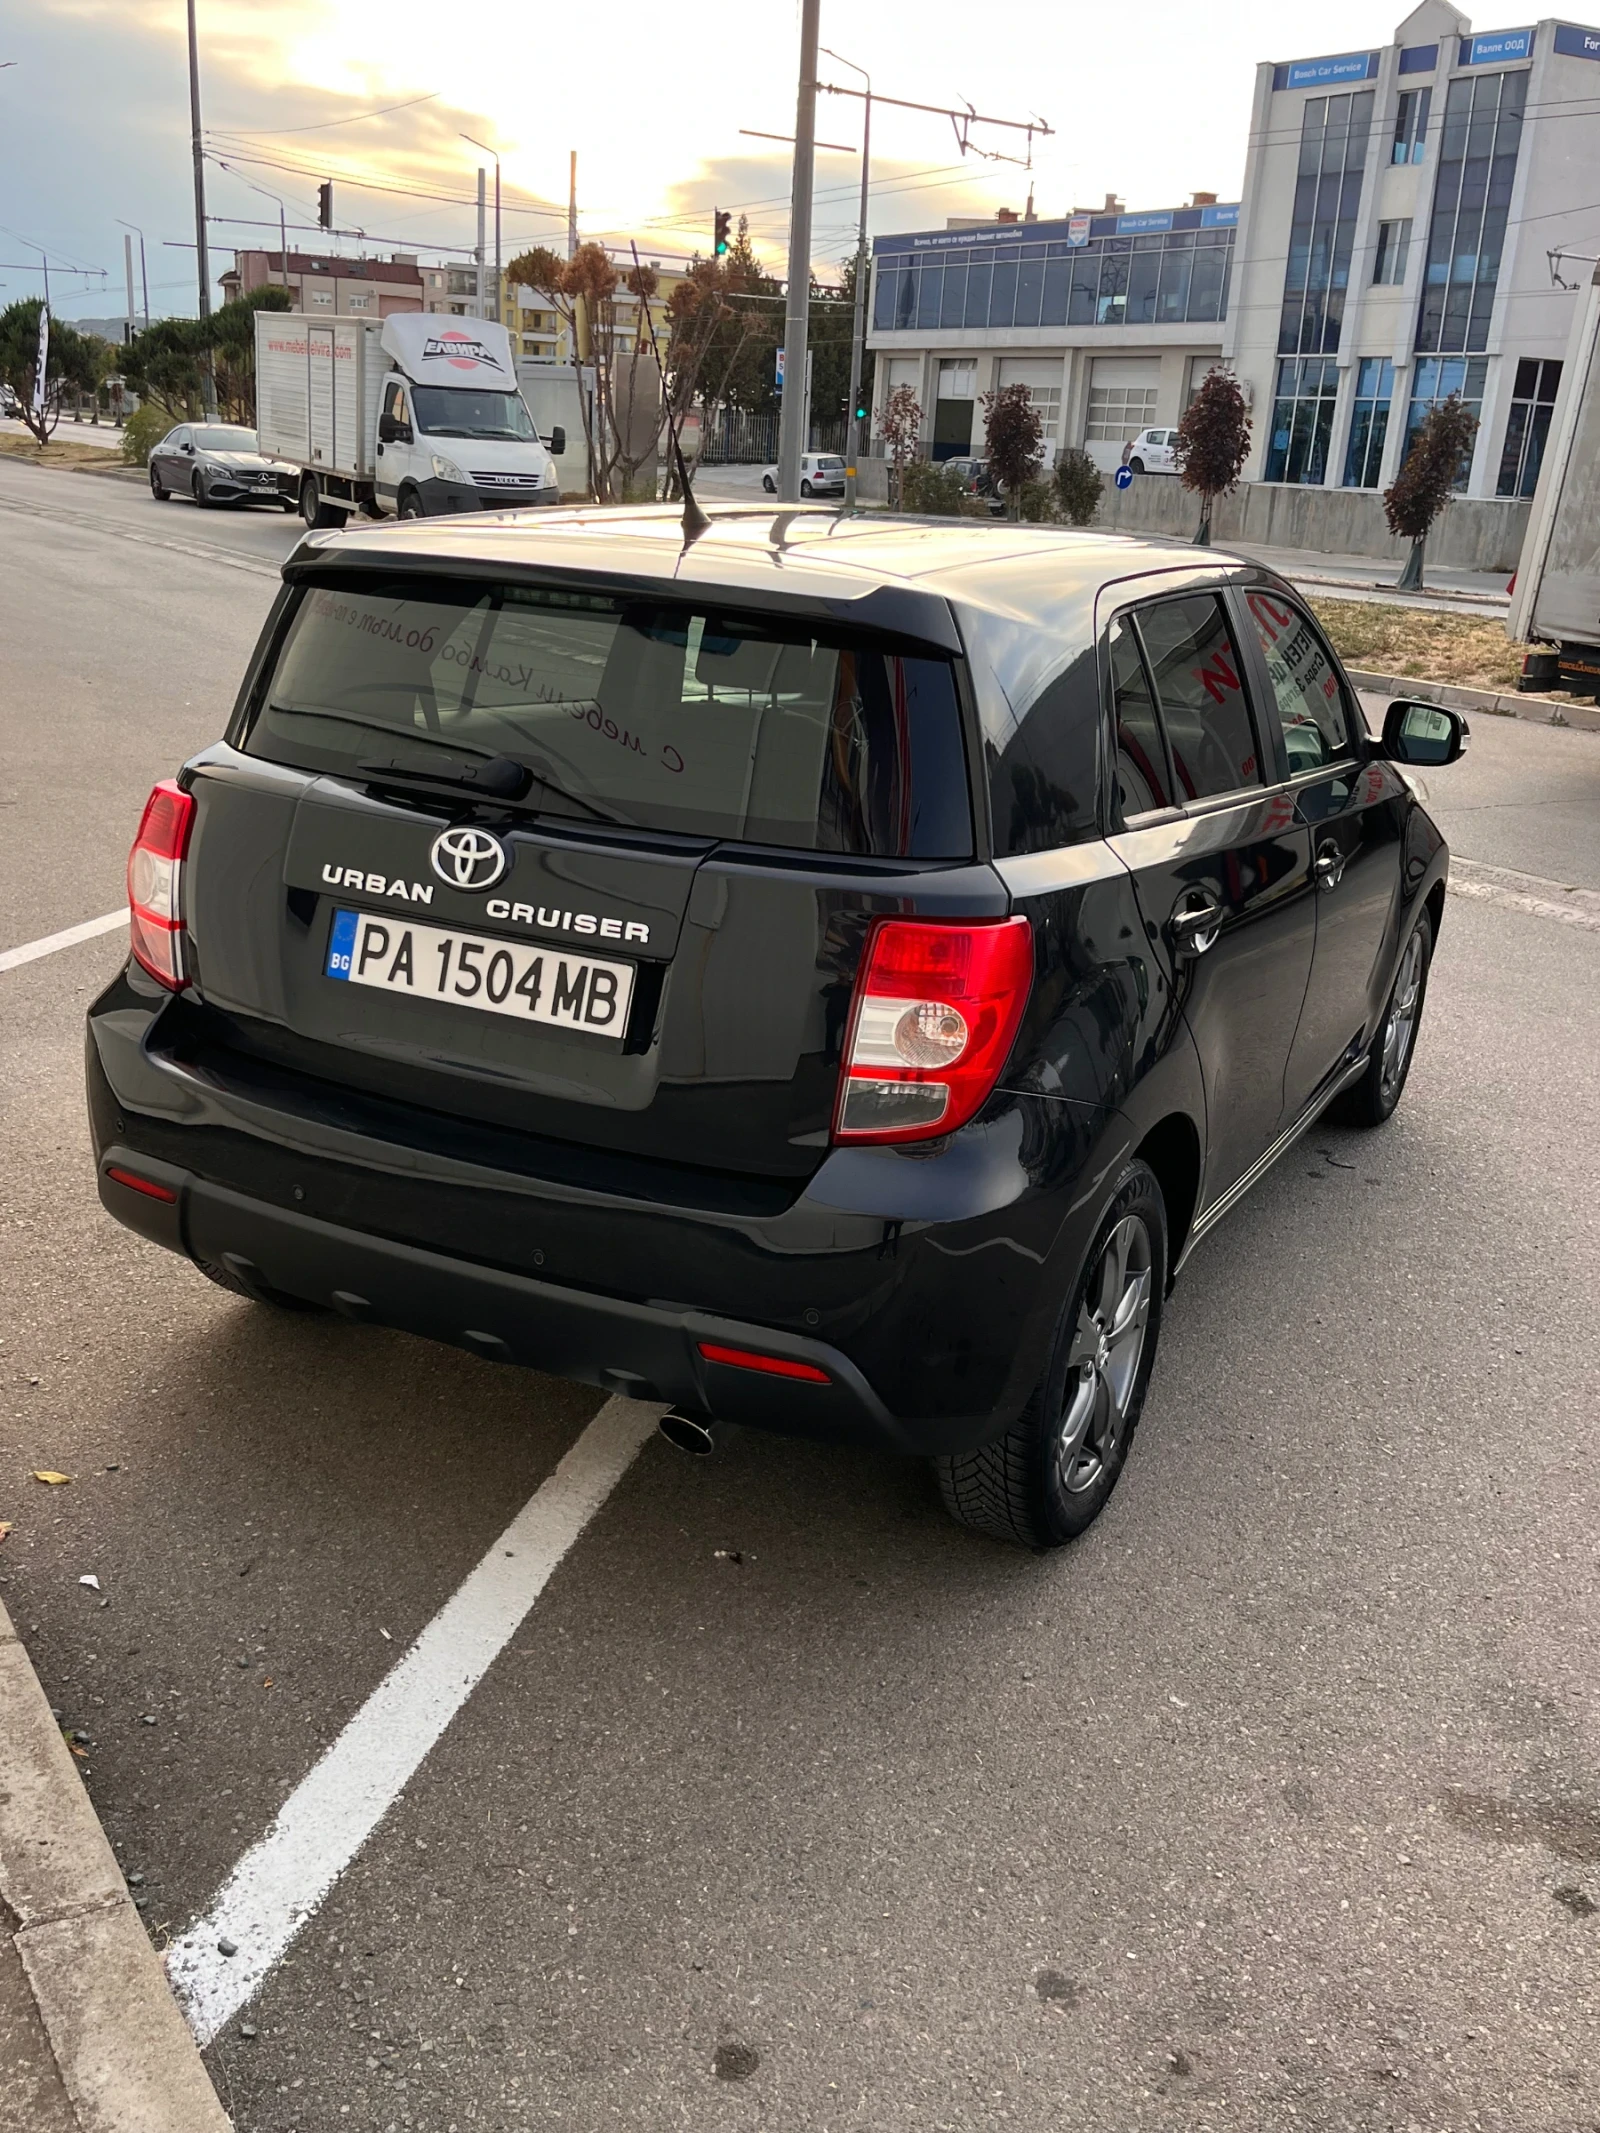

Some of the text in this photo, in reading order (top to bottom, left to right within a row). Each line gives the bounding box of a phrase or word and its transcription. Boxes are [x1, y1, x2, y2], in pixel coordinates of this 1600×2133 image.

[1504, 39, 1525, 51] ООД
[1293, 62, 1362, 80] Bosch Car Service
[425, 341, 494, 359] ЕЛВИРА
[495, 475, 520, 485] IVECO
[321, 863, 434, 905] URBAN
[486, 899, 651, 943] CRUISER
[330, 952, 350, 971] BG
[357, 922, 619, 1027] PA 1504 MB
